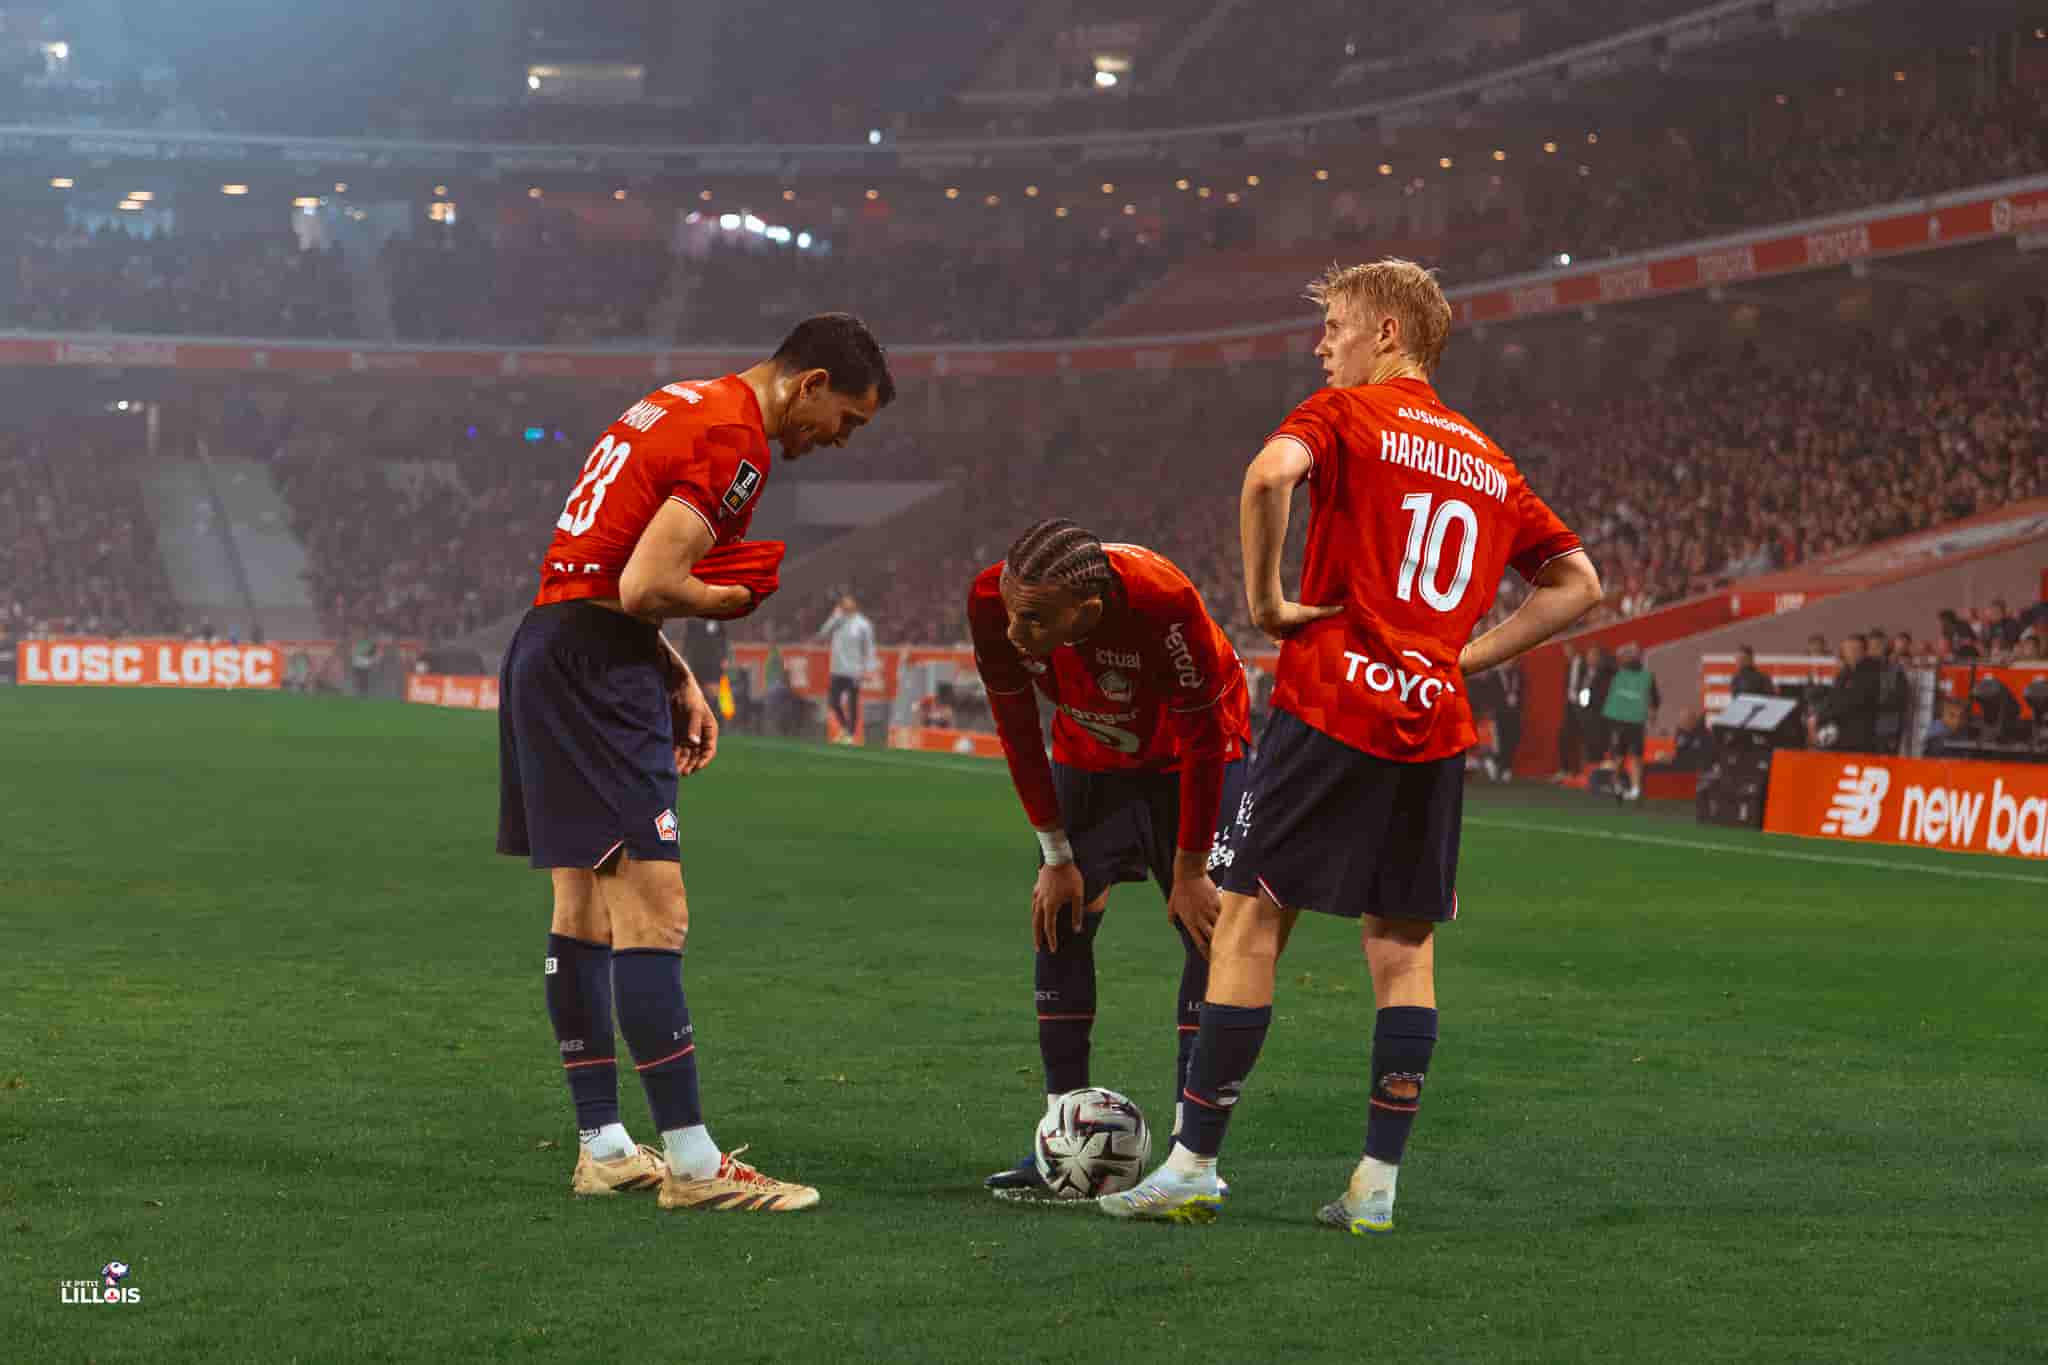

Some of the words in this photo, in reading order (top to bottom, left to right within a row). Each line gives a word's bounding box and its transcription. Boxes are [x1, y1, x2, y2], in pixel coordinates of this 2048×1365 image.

[1380, 430, 1508, 503] HARALDSSON
[1397, 493, 1478, 612] 10
[25, 645, 143, 682] LOSC
[157, 647, 273, 685] LOSC
[1899, 785, 1984, 846] new
